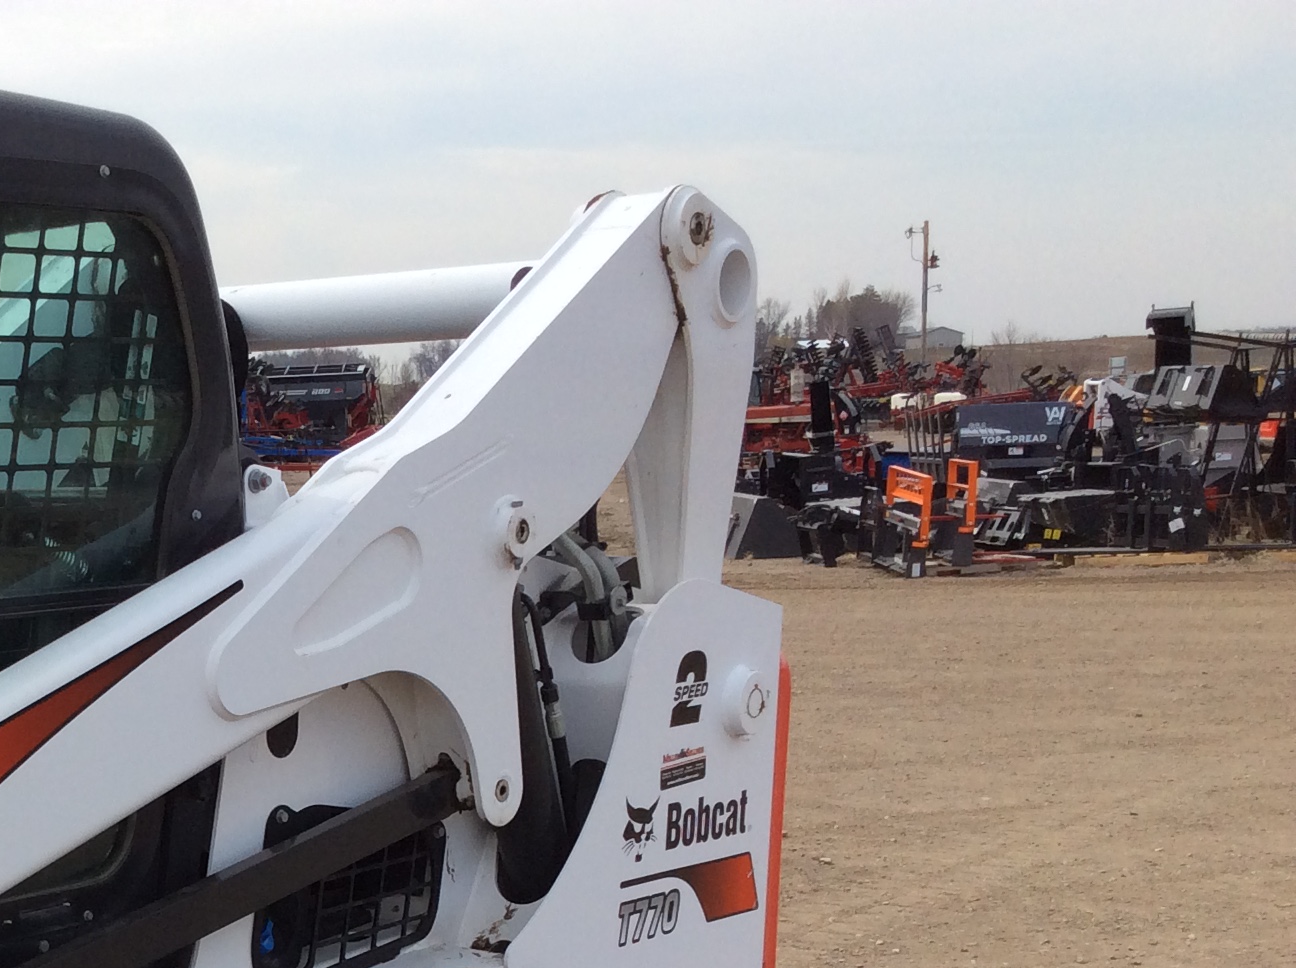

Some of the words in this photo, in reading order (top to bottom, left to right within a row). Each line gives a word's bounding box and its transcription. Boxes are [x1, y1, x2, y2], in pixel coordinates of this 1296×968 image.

[981, 434, 1048, 445] TOP-SPREAD
[673, 682, 709, 701] SPEED
[666, 790, 748, 851] Bobcat
[618, 889, 681, 947] T770
